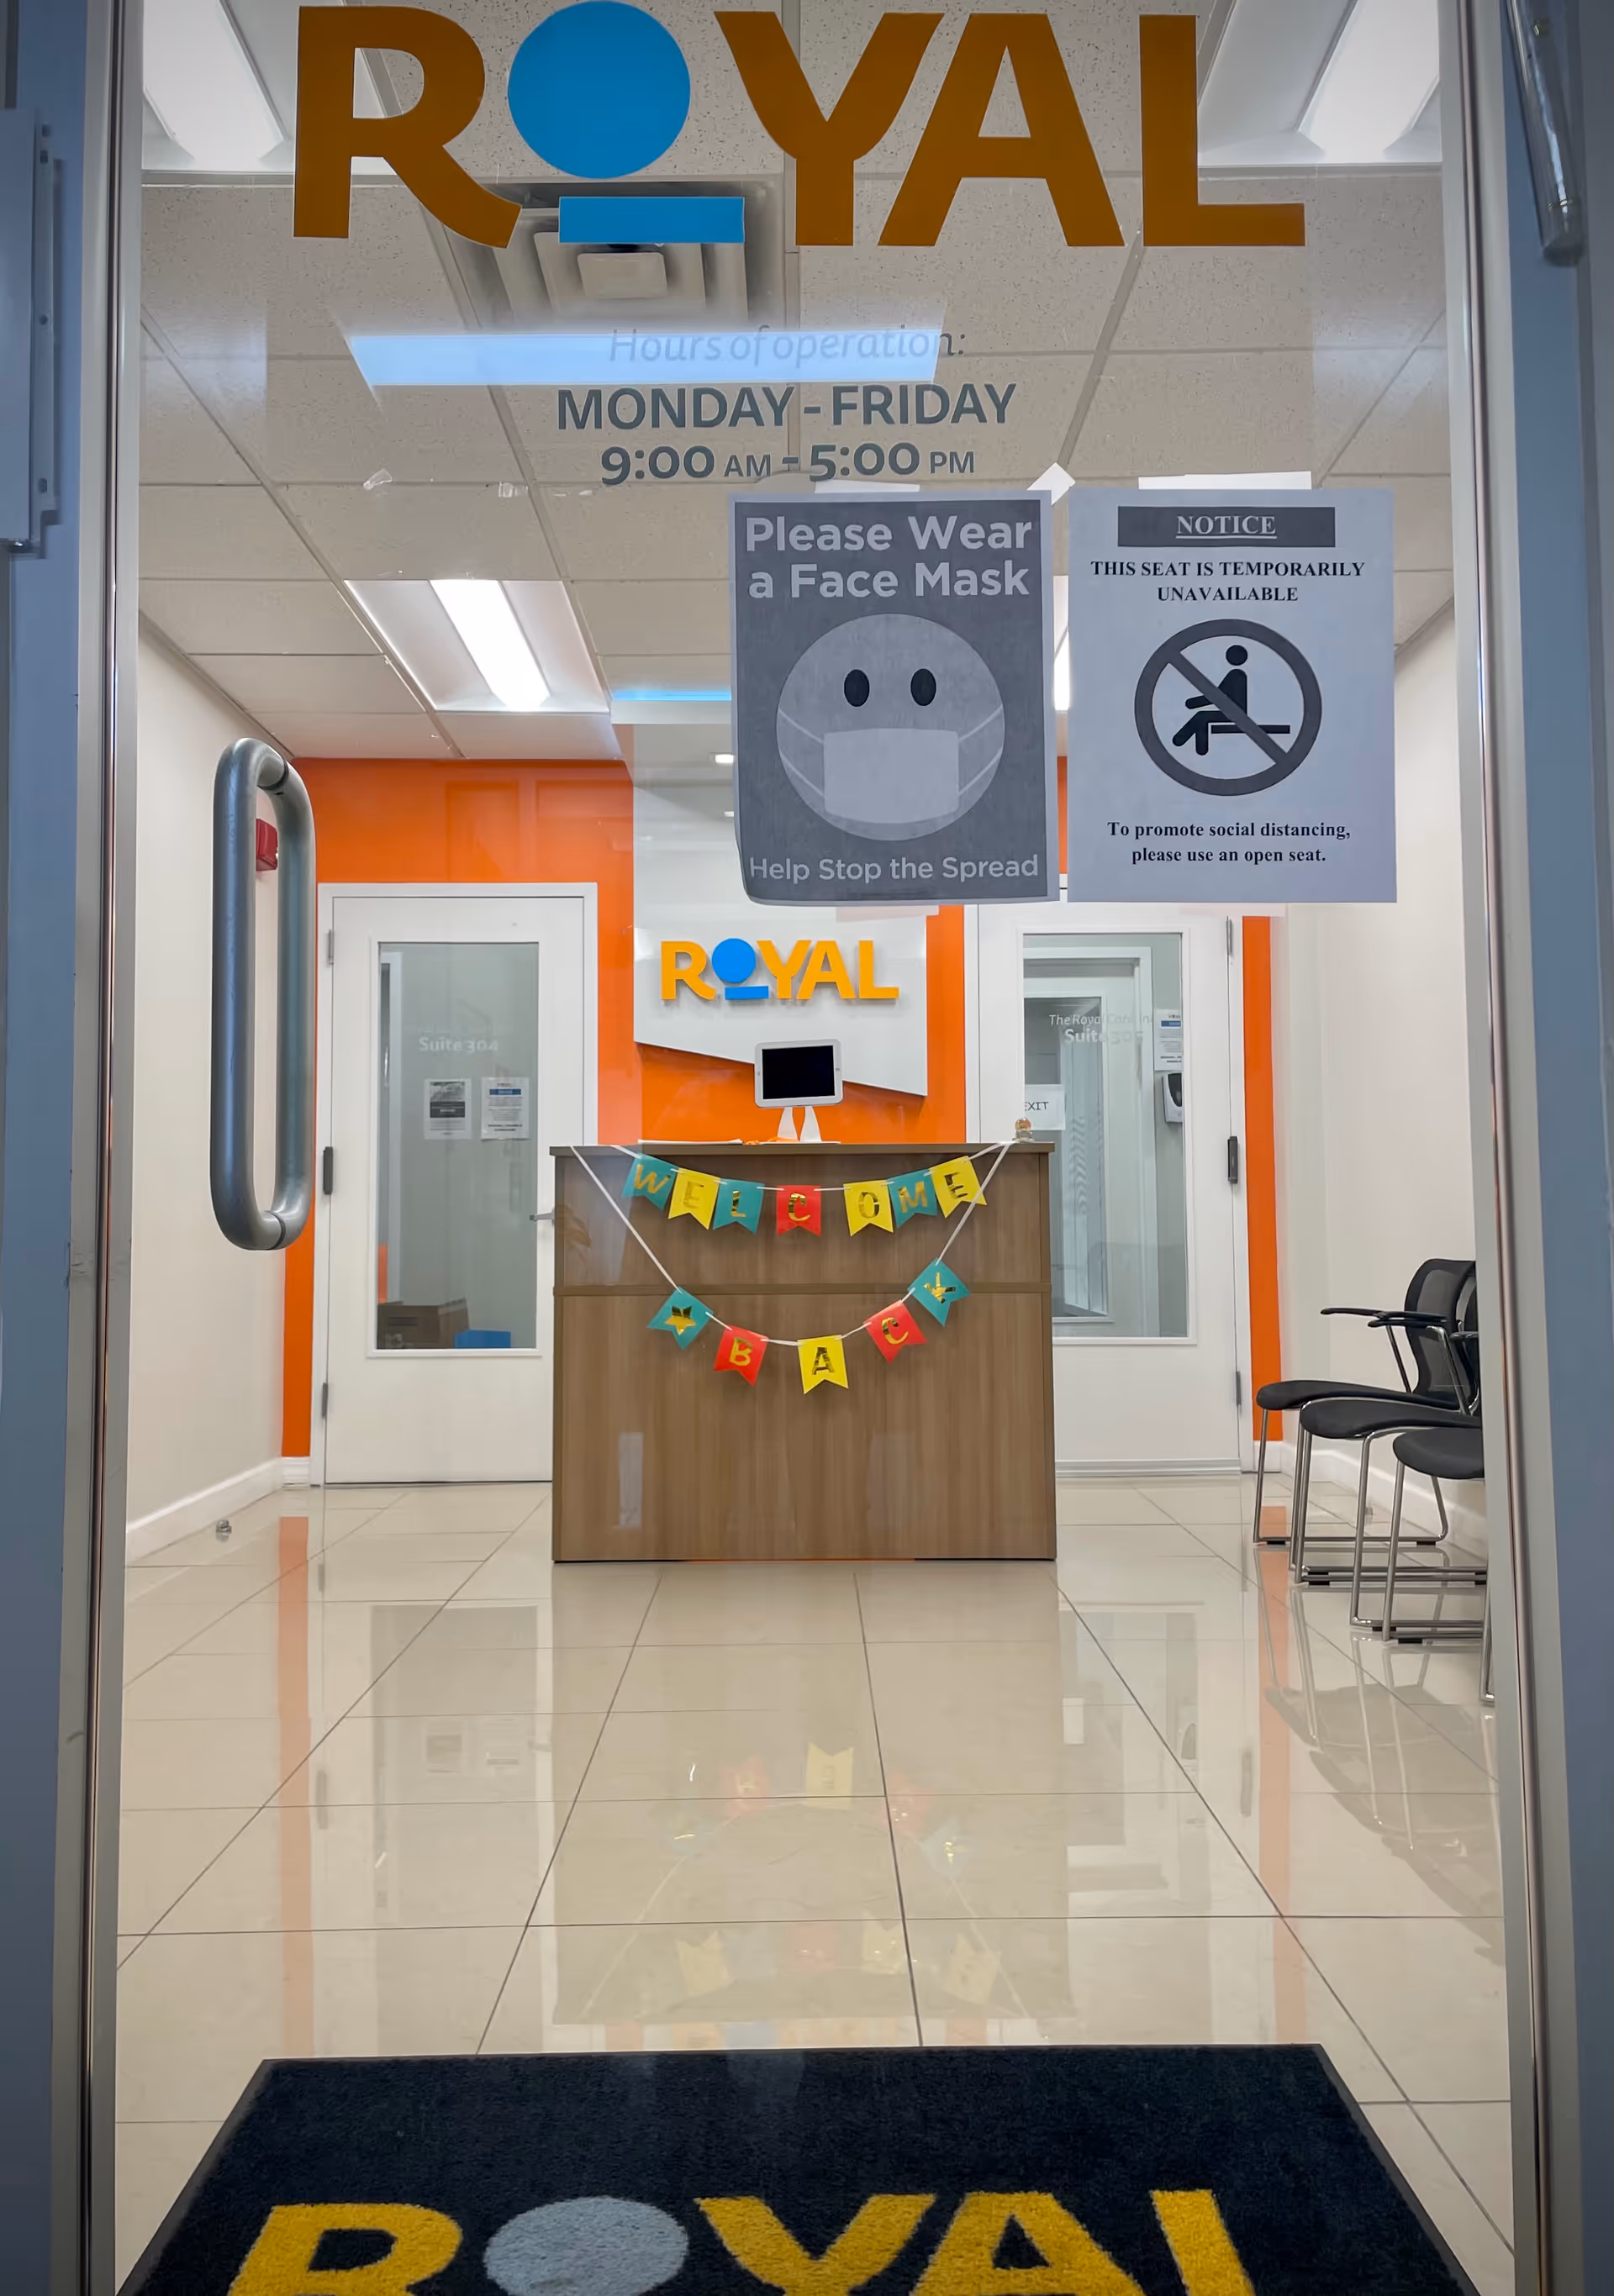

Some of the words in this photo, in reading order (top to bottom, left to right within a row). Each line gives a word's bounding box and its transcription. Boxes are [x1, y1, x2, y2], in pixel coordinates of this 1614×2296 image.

[293, 1, 1305, 249] ROYAL
[610, 329, 722, 362] Hours
[731, 325, 771, 366] of
[773, 325, 966, 368] operation:
[601, 445, 715, 485] 9:00
[724, 455, 772, 477] AM
[810, 442, 920, 482] 5:00
[930, 451, 975, 474] PM
[746, 516, 893, 551] Please
[908, 514, 1032, 551] Wear
[1176, 513, 1277, 539] NOTICE
[748, 570, 774, 599] a
[790, 563, 899, 598] Face
[915, 559, 1030, 597] Mask
[1090, 561, 1137, 577] THIS
[1141, 560, 1191, 577] SEAT
[1195, 561, 1215, 577] IS
[1219, 560, 1366, 577] TEMPORARILY
[1157, 585, 1299, 603] UNAVAILABLE
[1107, 822, 1131, 838] To
[1135, 824, 1204, 843] promote
[1209, 820, 1256, 838] social
[1260, 820, 1352, 843] distancing,
[749, 857, 810, 884] Help
[819, 858, 882, 883] Stop
[889, 856, 934, 880] the
[942, 854, 1039, 882] Spread
[1131, 847, 1182, 866] please
[1187, 850, 1214, 863] use
[1219, 850, 1239, 863] an
[1244, 850, 1284, 866] open
[1290, 849, 1327, 863] seat.
[660, 937, 899, 1001] ROYAL
[1049, 1014, 1071, 1025] The
[1072, 1014, 1105, 1026] Roya
[419, 1036, 462, 1052] Suite
[633, 1164, 969, 1222] WELCOME
[729, 1272, 957, 1376] BACK
